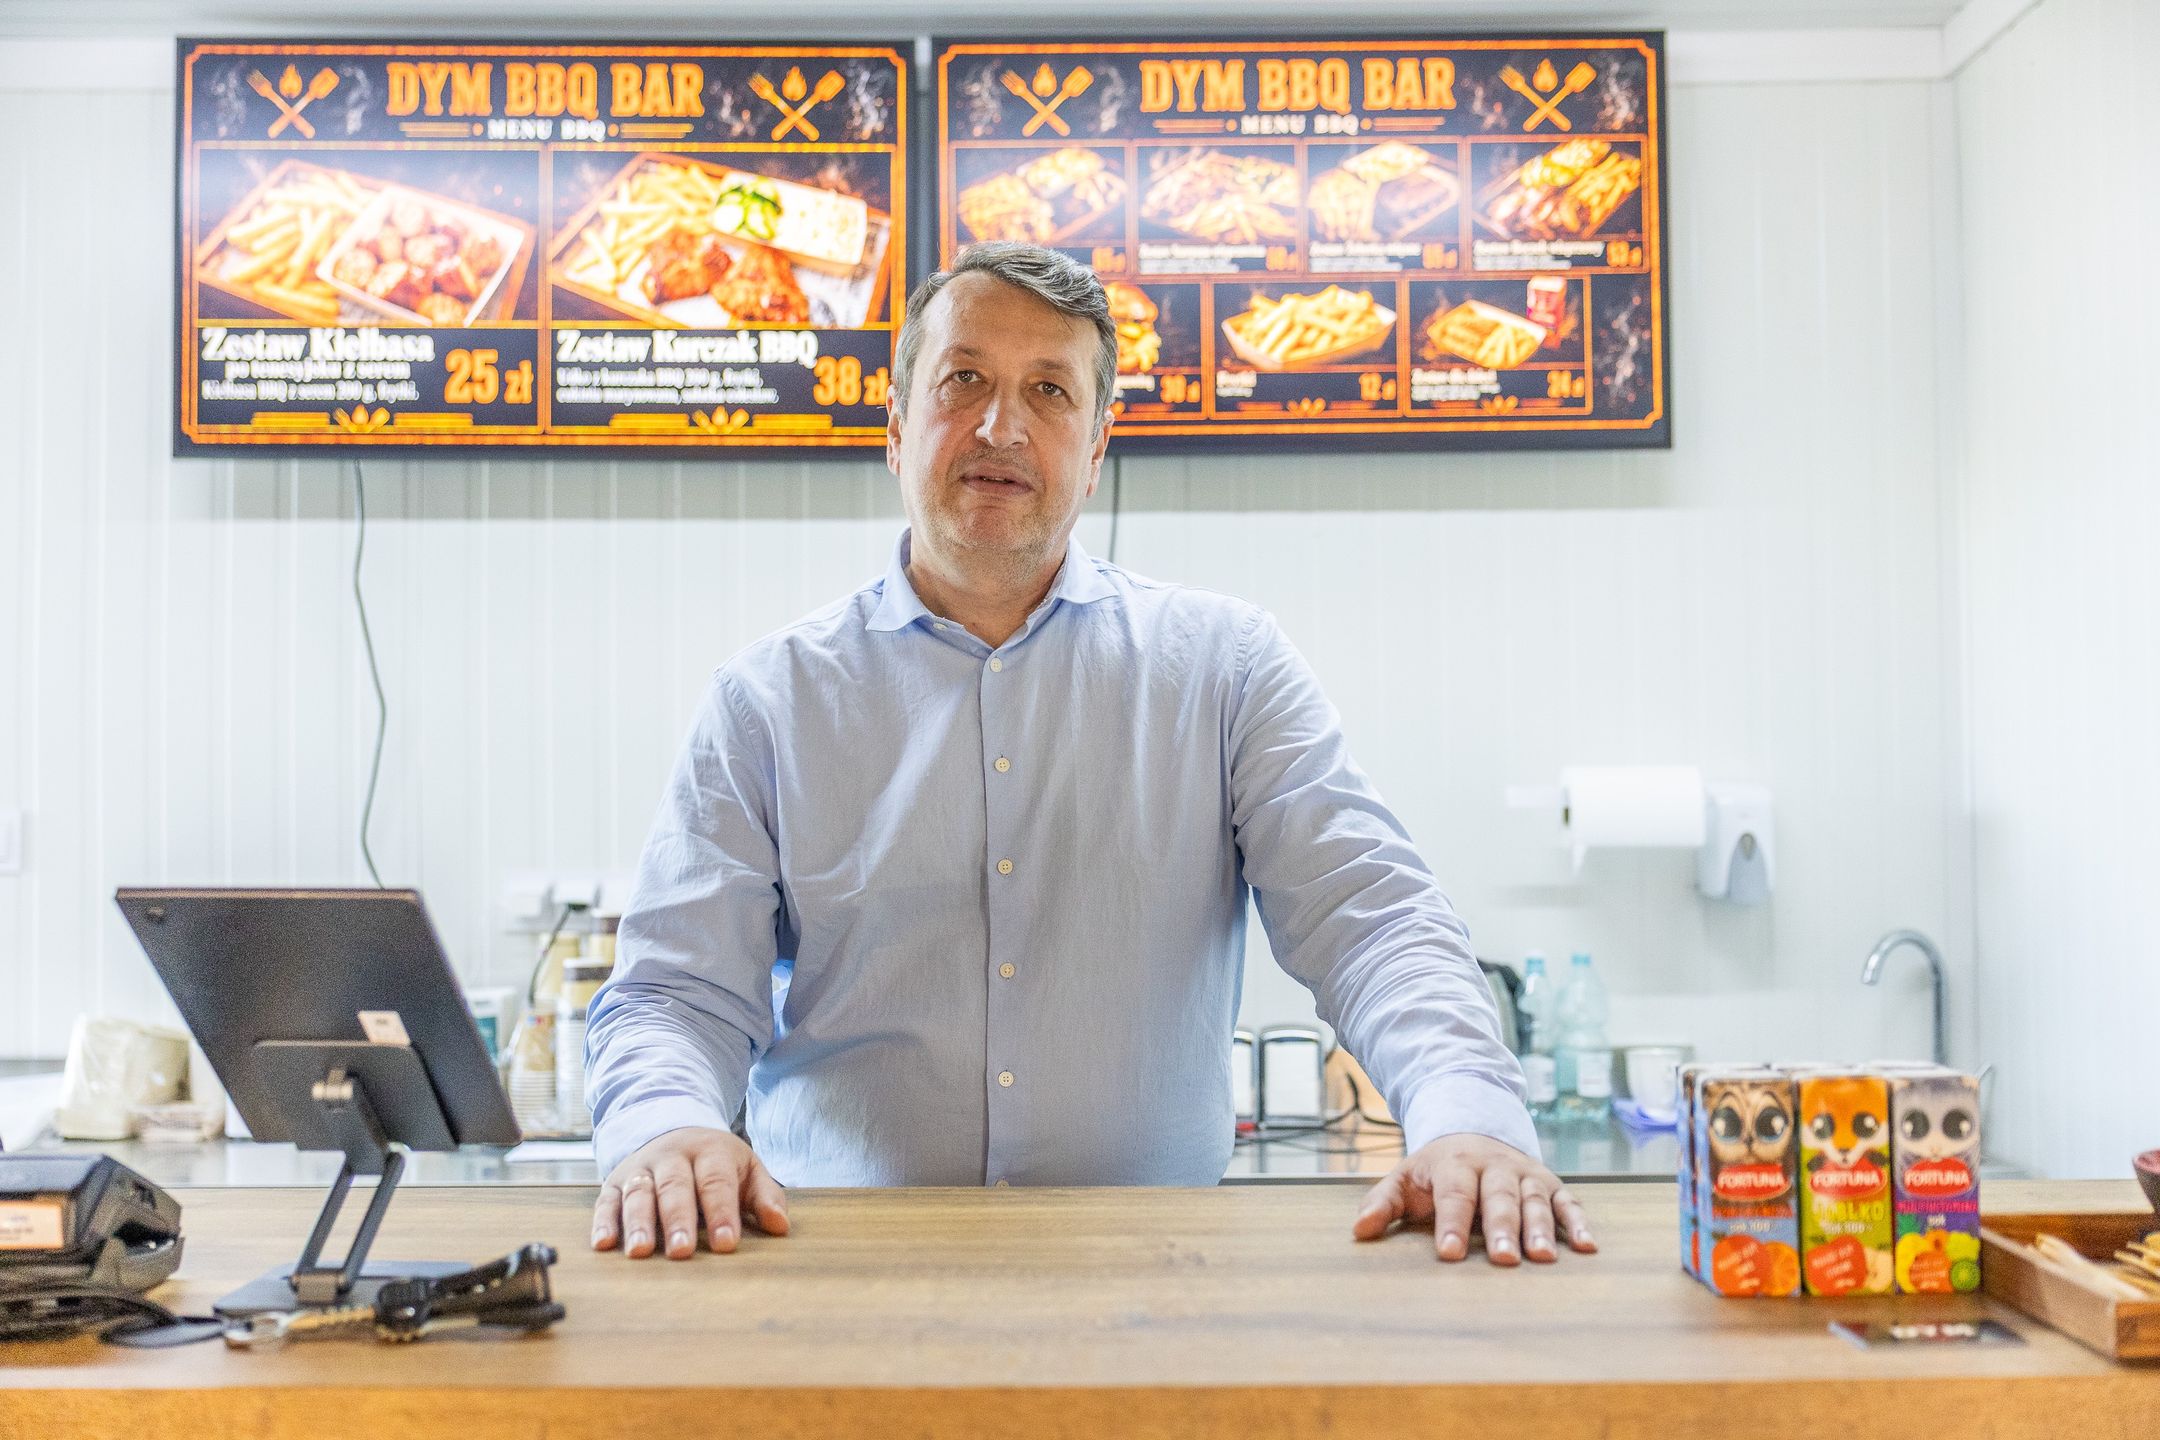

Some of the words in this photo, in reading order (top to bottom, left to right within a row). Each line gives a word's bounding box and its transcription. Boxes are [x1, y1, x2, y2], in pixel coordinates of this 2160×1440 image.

[386, 62, 492, 116] DYM
[505, 62, 599, 120] BBQ
[610, 62, 705, 117] BAR
[1139, 59, 1246, 112] DYM
[1257, 58, 1352, 114] BBQ
[1361, 57, 1457, 110] BAR
[487, 119, 552, 140] MENU
[561, 119, 606, 142] BBQ
[1240, 114, 1306, 135] MENU
[1314, 114, 1359, 135] BBQ
[201, 327, 307, 361] Zestaw
[556, 330, 652, 362] Zestaw
[652, 330, 759, 363] Kurczak
[758, 330, 818, 369] BBQ
[444, 348, 499, 404] 25
[504, 359, 534, 404] zł
[813, 355, 861, 405] 38
[863, 366, 889, 405] zł
[1717, 1171, 1786, 1189] FORTUNA
[1811, 1170, 1881, 1187] FORTUNA
[1903, 1169, 1971, 1187] FORTUNA
